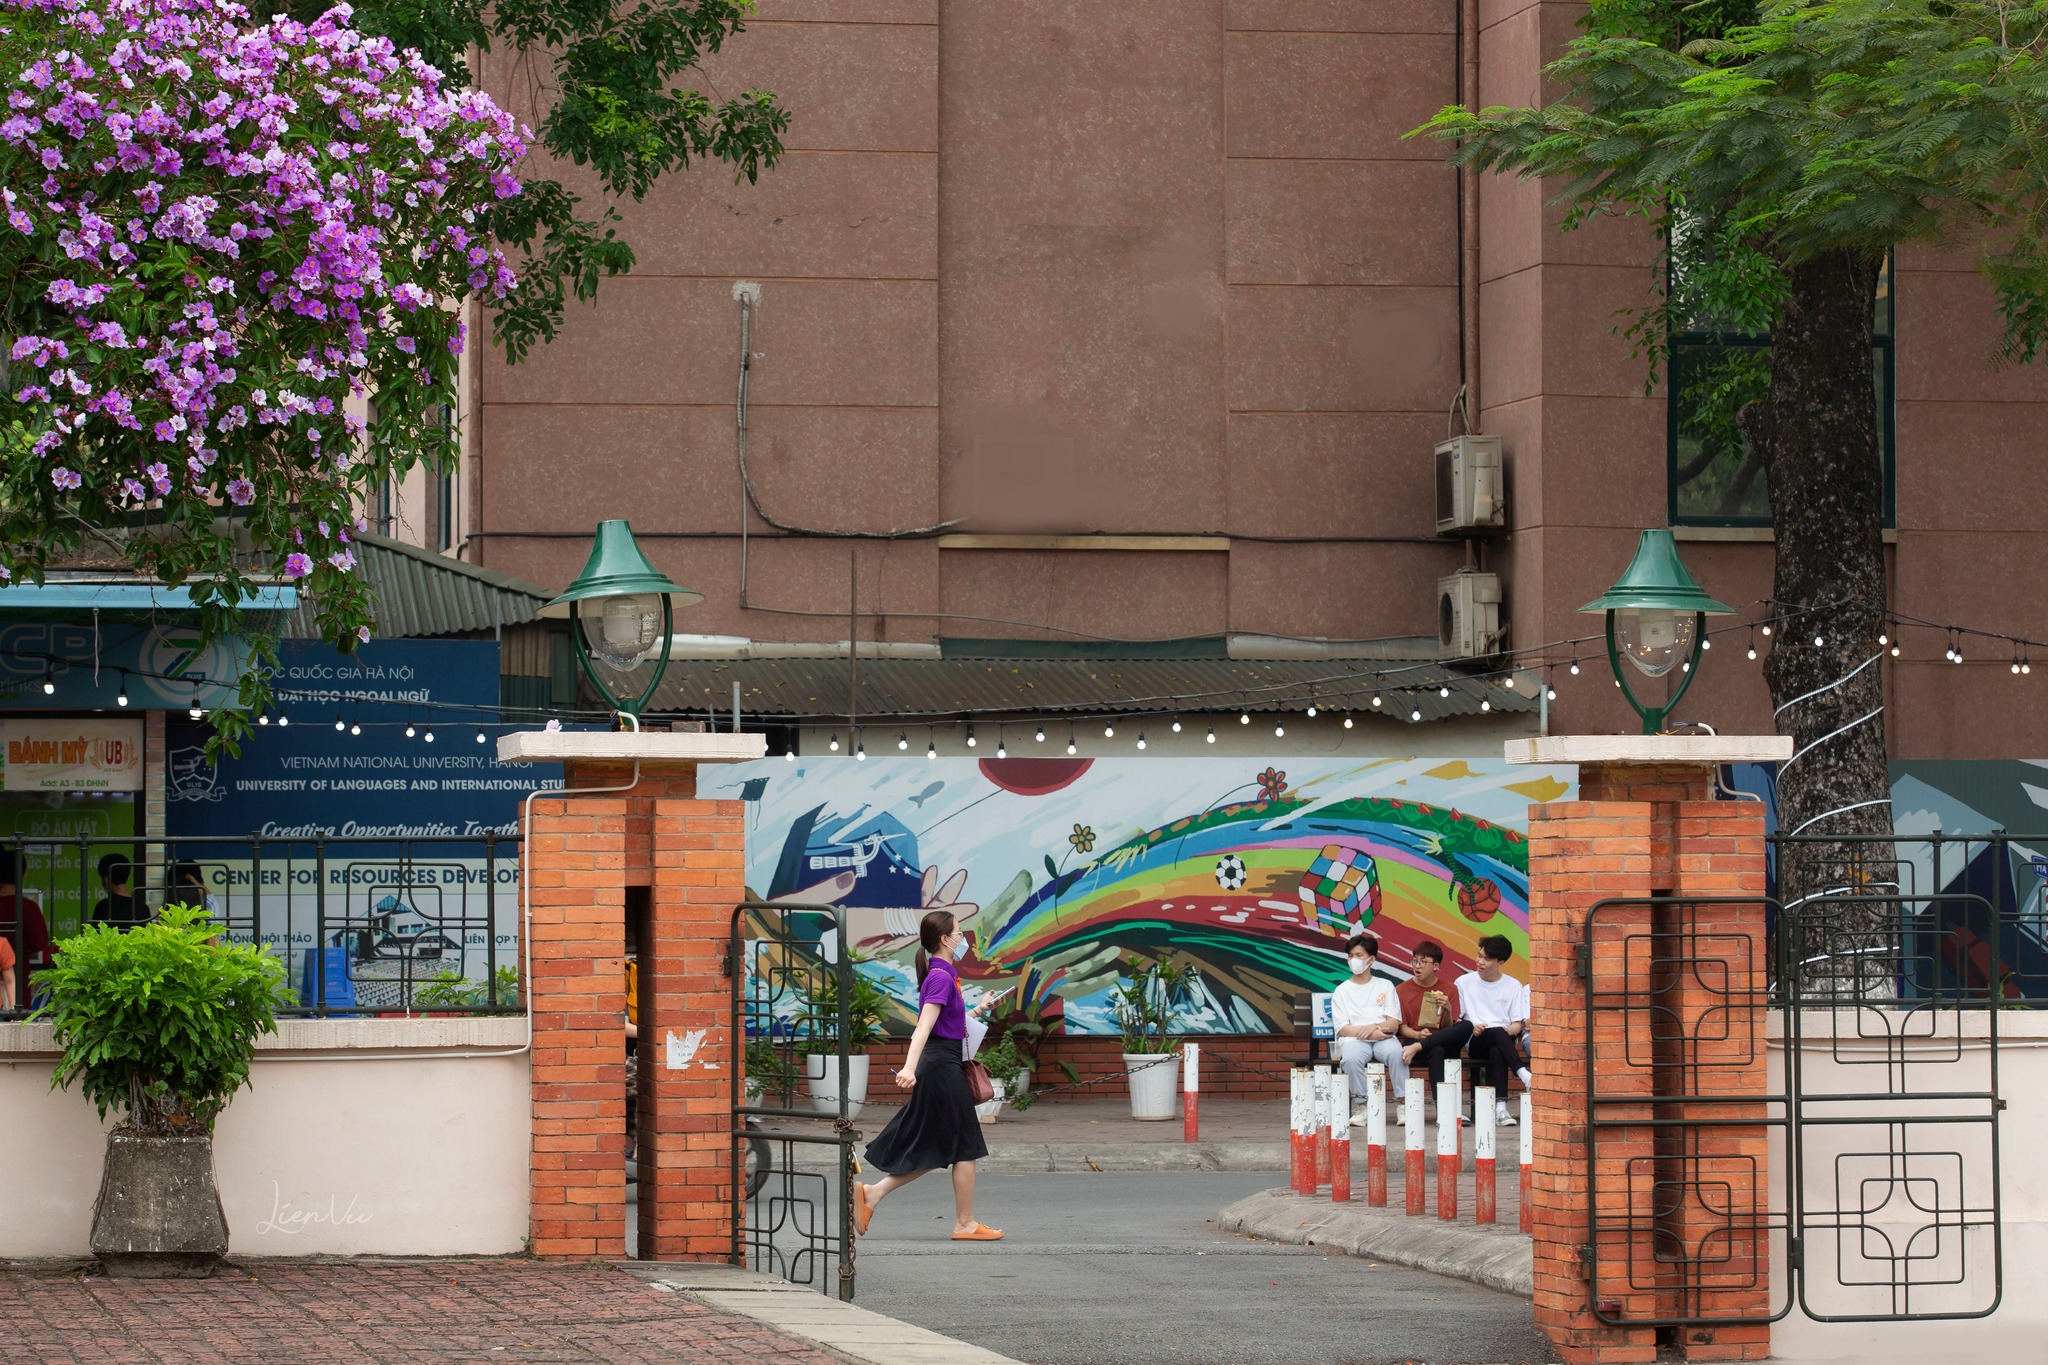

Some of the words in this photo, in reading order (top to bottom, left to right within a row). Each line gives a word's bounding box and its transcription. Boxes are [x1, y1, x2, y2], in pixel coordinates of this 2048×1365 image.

[289, 664, 333, 680] QUỐC
[337, 667, 363, 680] GIA
[366, 665, 386, 680] HÀ
[389, 665, 414, 682] NỘI
[9, 735, 59, 764] BÁNH
[105, 740, 123, 765] UB
[281, 756, 339, 769] VIETNAM
[343, 756, 409, 769] NATIONAL
[413, 756, 485, 769] UNIVERSITY,
[236, 780, 307, 791] UNIVERSITY
[310, 780, 328, 791] OF
[331, 779, 407, 791] LANGUAGES
[410, 779, 438, 791] AND
[442, 779, 538, 791] INTERNATIONAL
[341, 820, 458, 837] Opportunities
[212, 870, 281, 885] CENER
[330, 869, 437, 884] RESOURCES
[465, 933, 485, 944] LIÊN
[1315, 1028, 1334, 1036] ULIS
